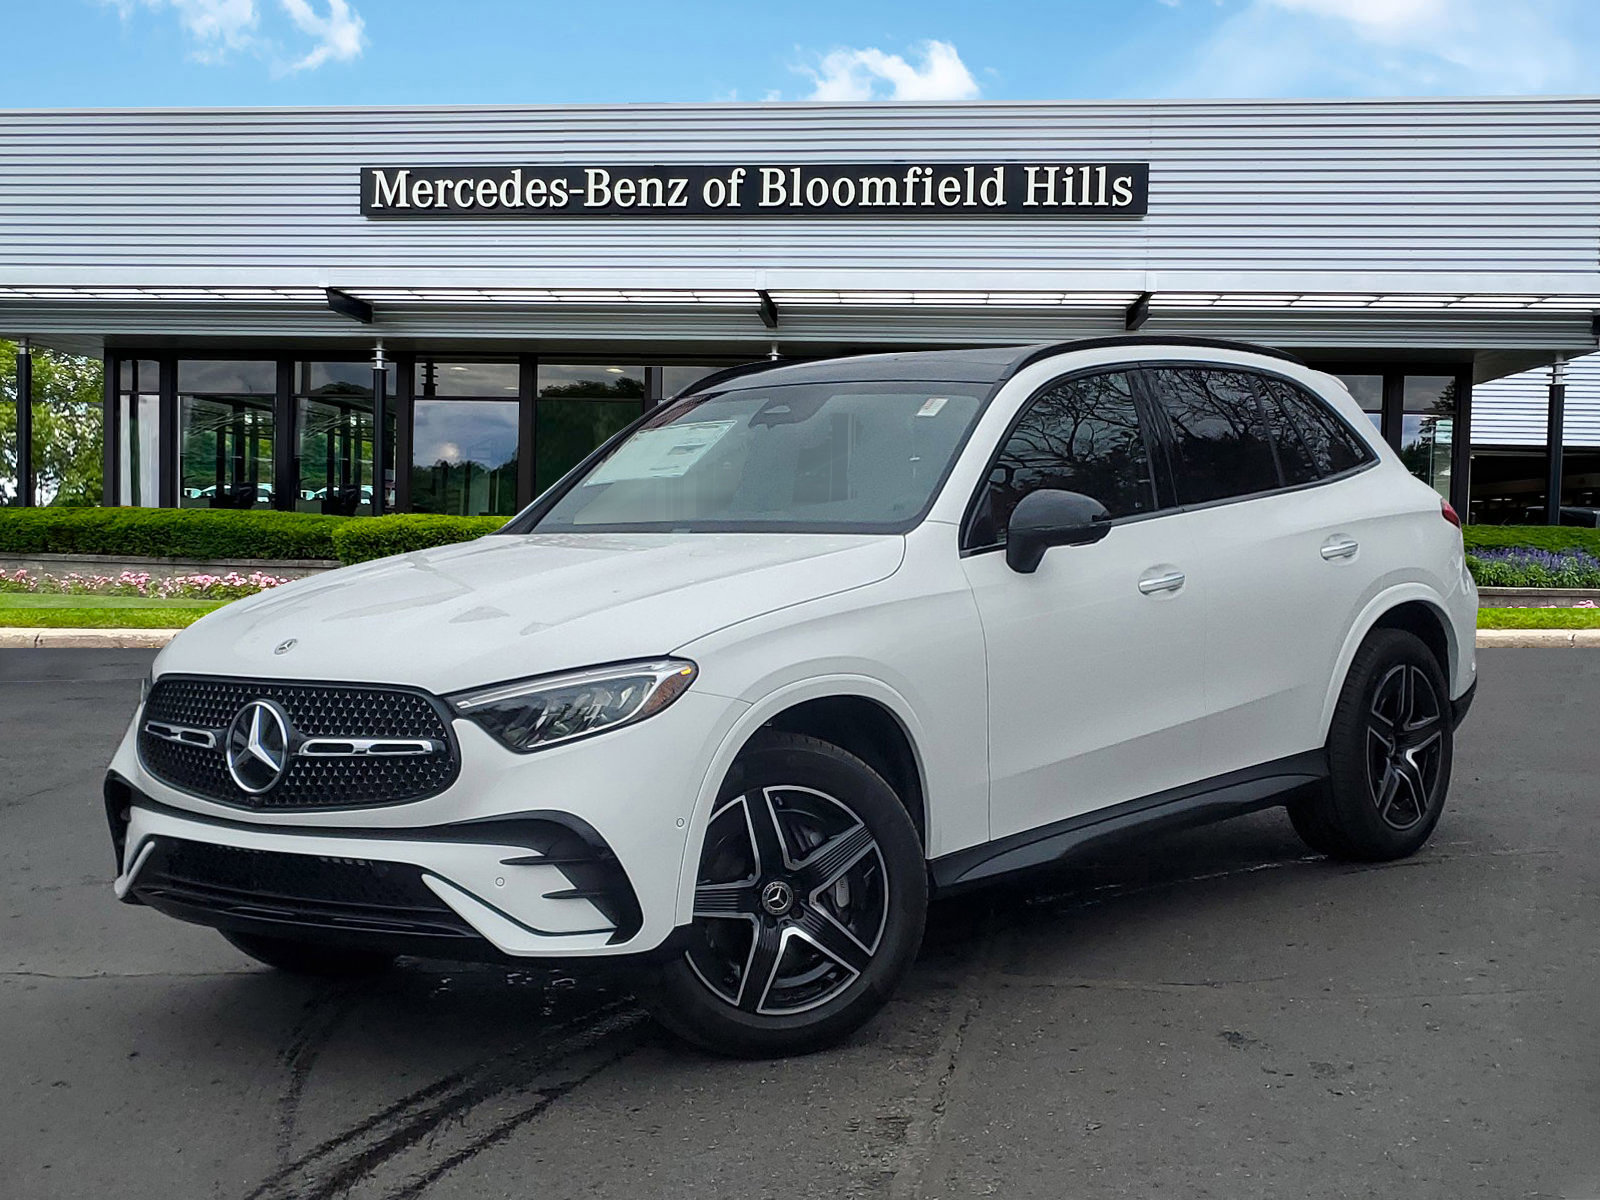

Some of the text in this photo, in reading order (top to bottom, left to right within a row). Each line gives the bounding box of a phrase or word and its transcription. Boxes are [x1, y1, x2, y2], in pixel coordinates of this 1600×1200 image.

[371, 165, 1134, 208] Mercedes-Benz of Bloomfield Hills
